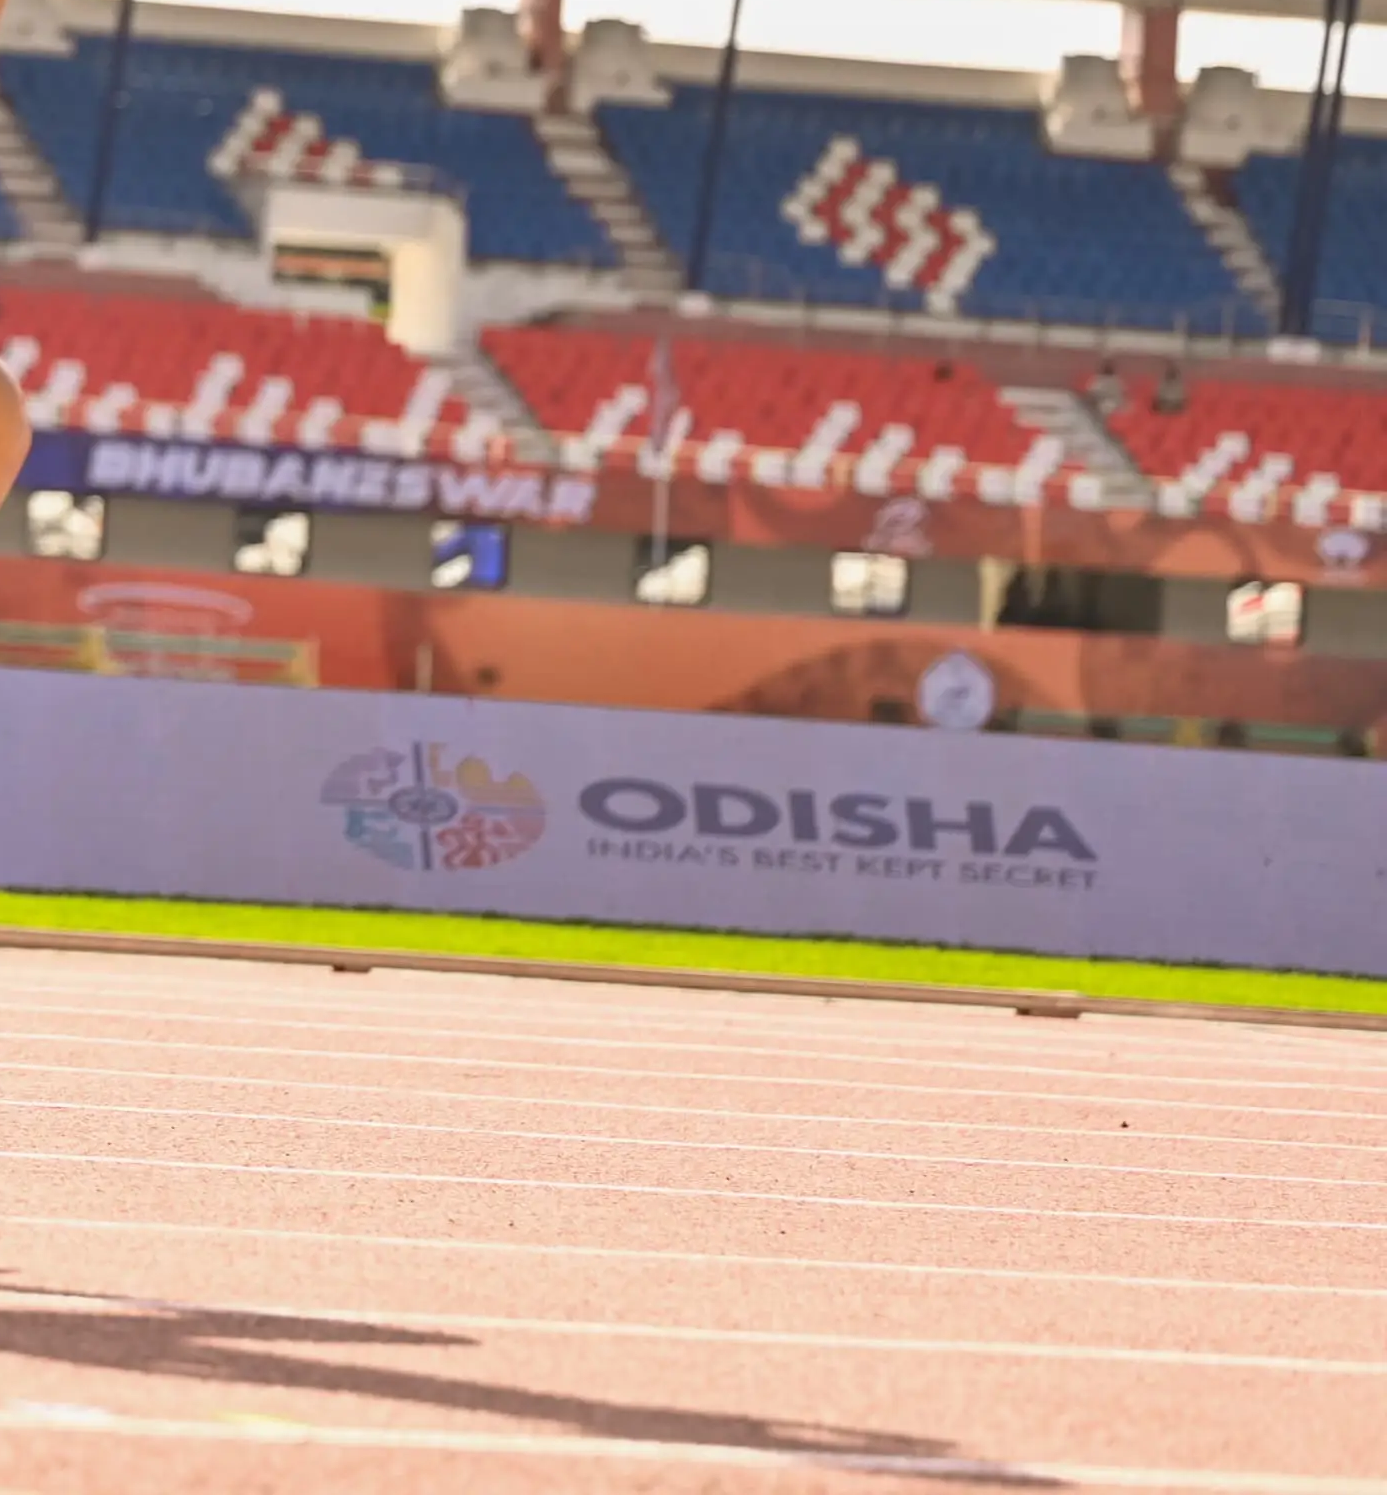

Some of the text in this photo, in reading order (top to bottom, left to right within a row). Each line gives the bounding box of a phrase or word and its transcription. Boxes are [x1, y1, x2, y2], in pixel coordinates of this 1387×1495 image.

[87, 439, 597, 523] BHUBANESWAR
[577, 777, 1100, 862] ODISHA
[585, 837, 1100, 892] INDIA'S BEST KEPT SECRET
